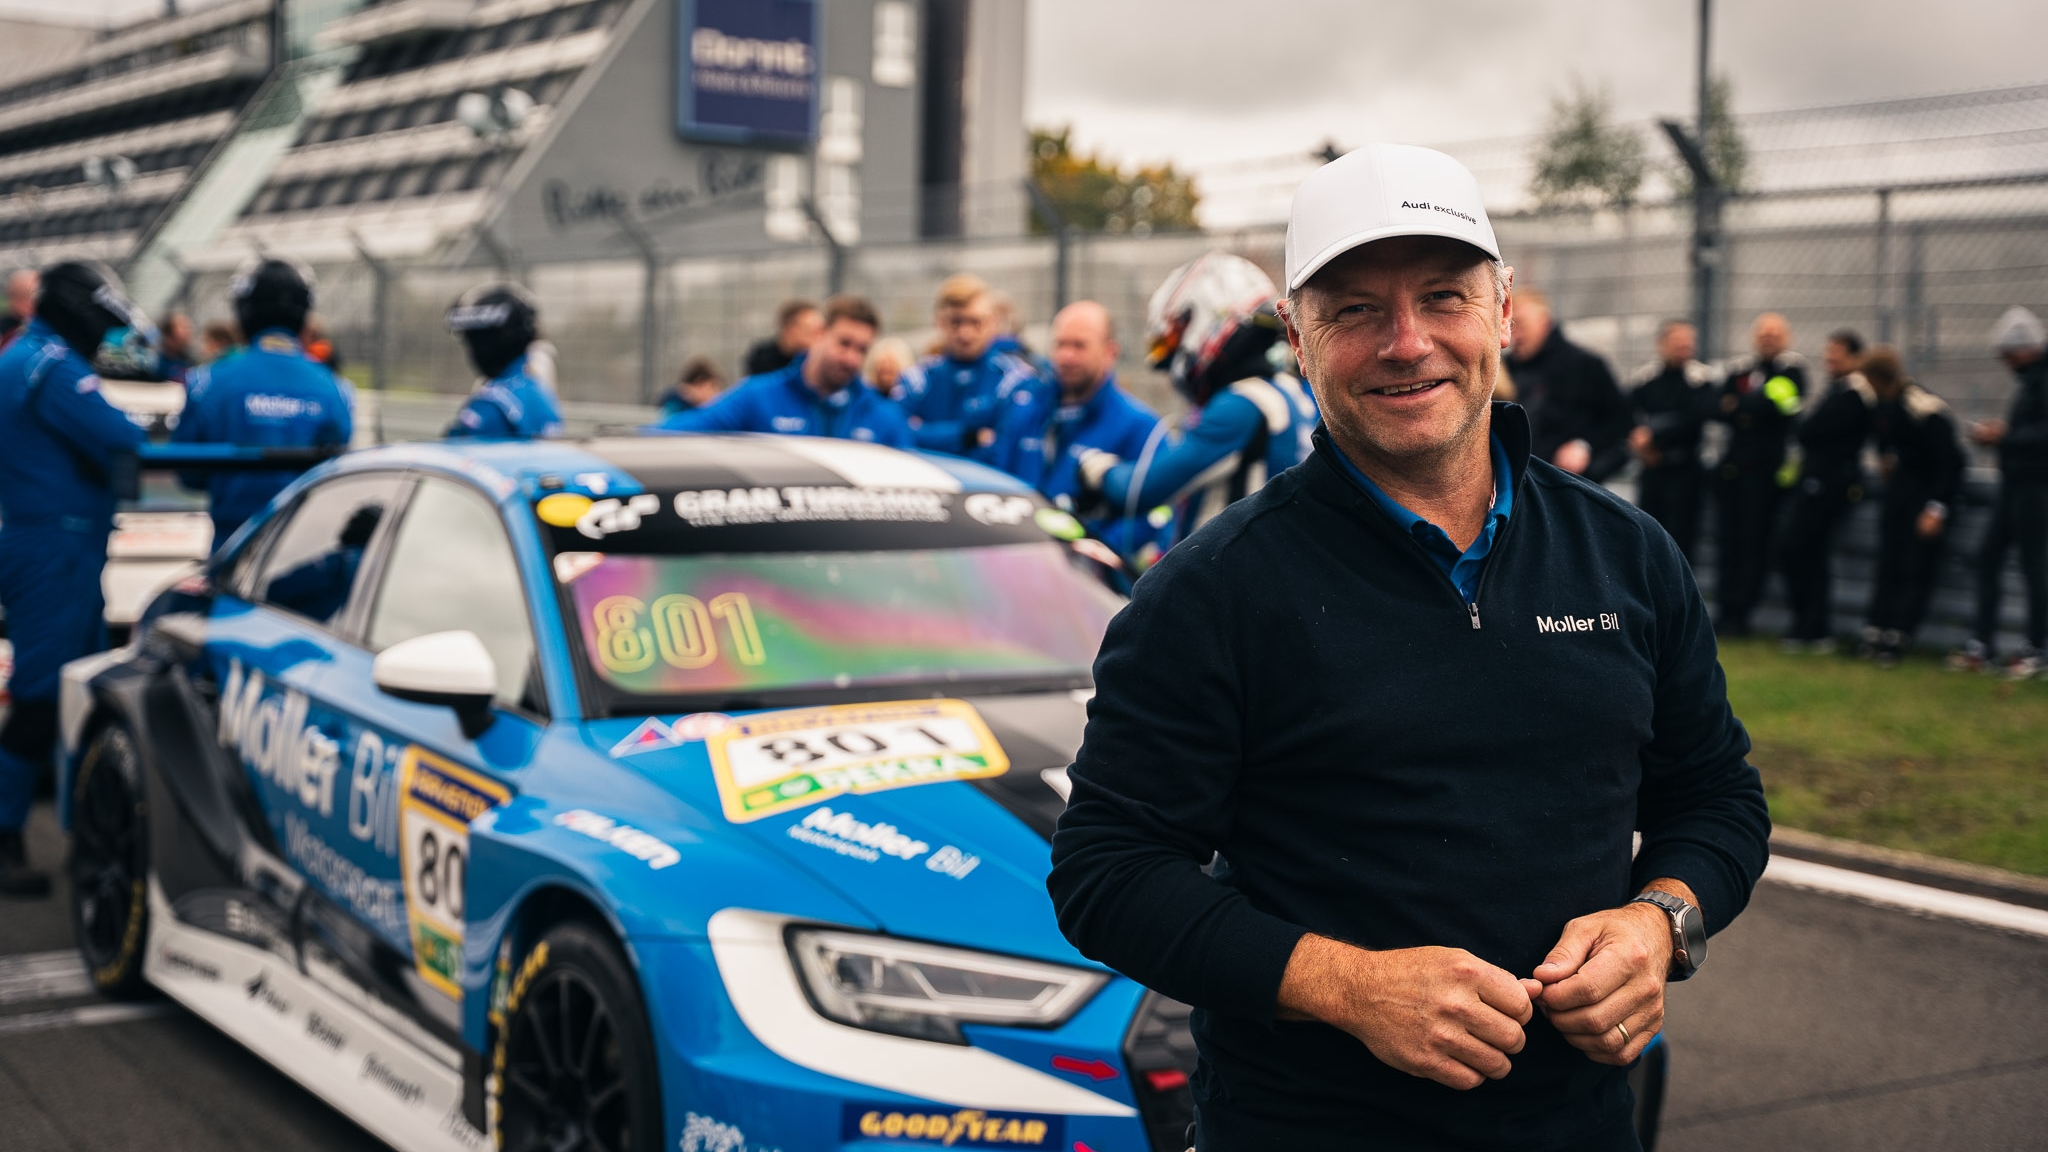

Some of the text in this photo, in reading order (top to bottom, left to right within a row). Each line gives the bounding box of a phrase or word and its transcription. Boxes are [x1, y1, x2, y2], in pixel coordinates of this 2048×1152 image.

[1401, 200, 1477, 225] Audi exclusive
[673, 489, 781, 520] GRAN
[592, 592, 767, 674] 801
[1599, 612, 1620, 630] Bil
[760, 726, 948, 767] 801
[813, 754, 986, 792] DEKRA
[349, 730, 402, 860] Bil
[925, 845, 981, 881] Bil
[859, 1108, 1049, 1146] GOODYEAR
